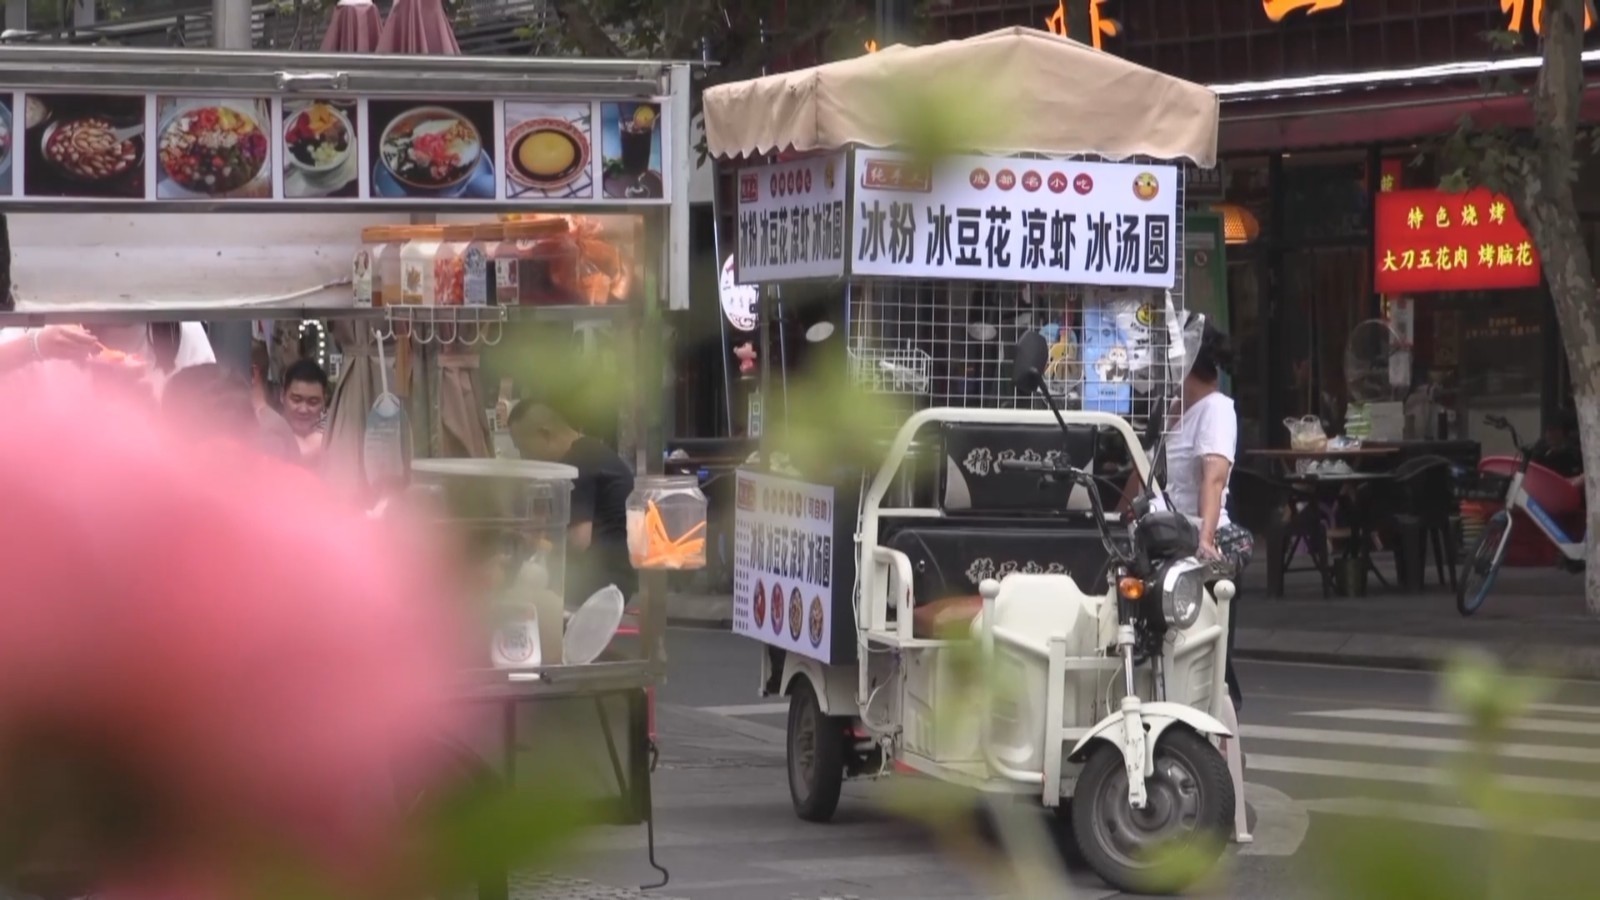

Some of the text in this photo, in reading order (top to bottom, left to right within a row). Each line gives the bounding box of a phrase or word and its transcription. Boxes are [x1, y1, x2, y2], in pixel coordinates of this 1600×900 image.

[971, 169, 1091, 193] 成都名小吃
[740, 200, 843, 268] 冰粉 冰豆花 凉虾 冰汤圆
[1407, 201, 1506, 230] 特色烧烤
[858, 200, 1170, 274] 冰粉 冰豆花 凉虾 冰汤圆
[1382, 241, 1533, 272] 大刀五花肉 烤脑花
[806, 534, 831, 588] 冰汤圆
